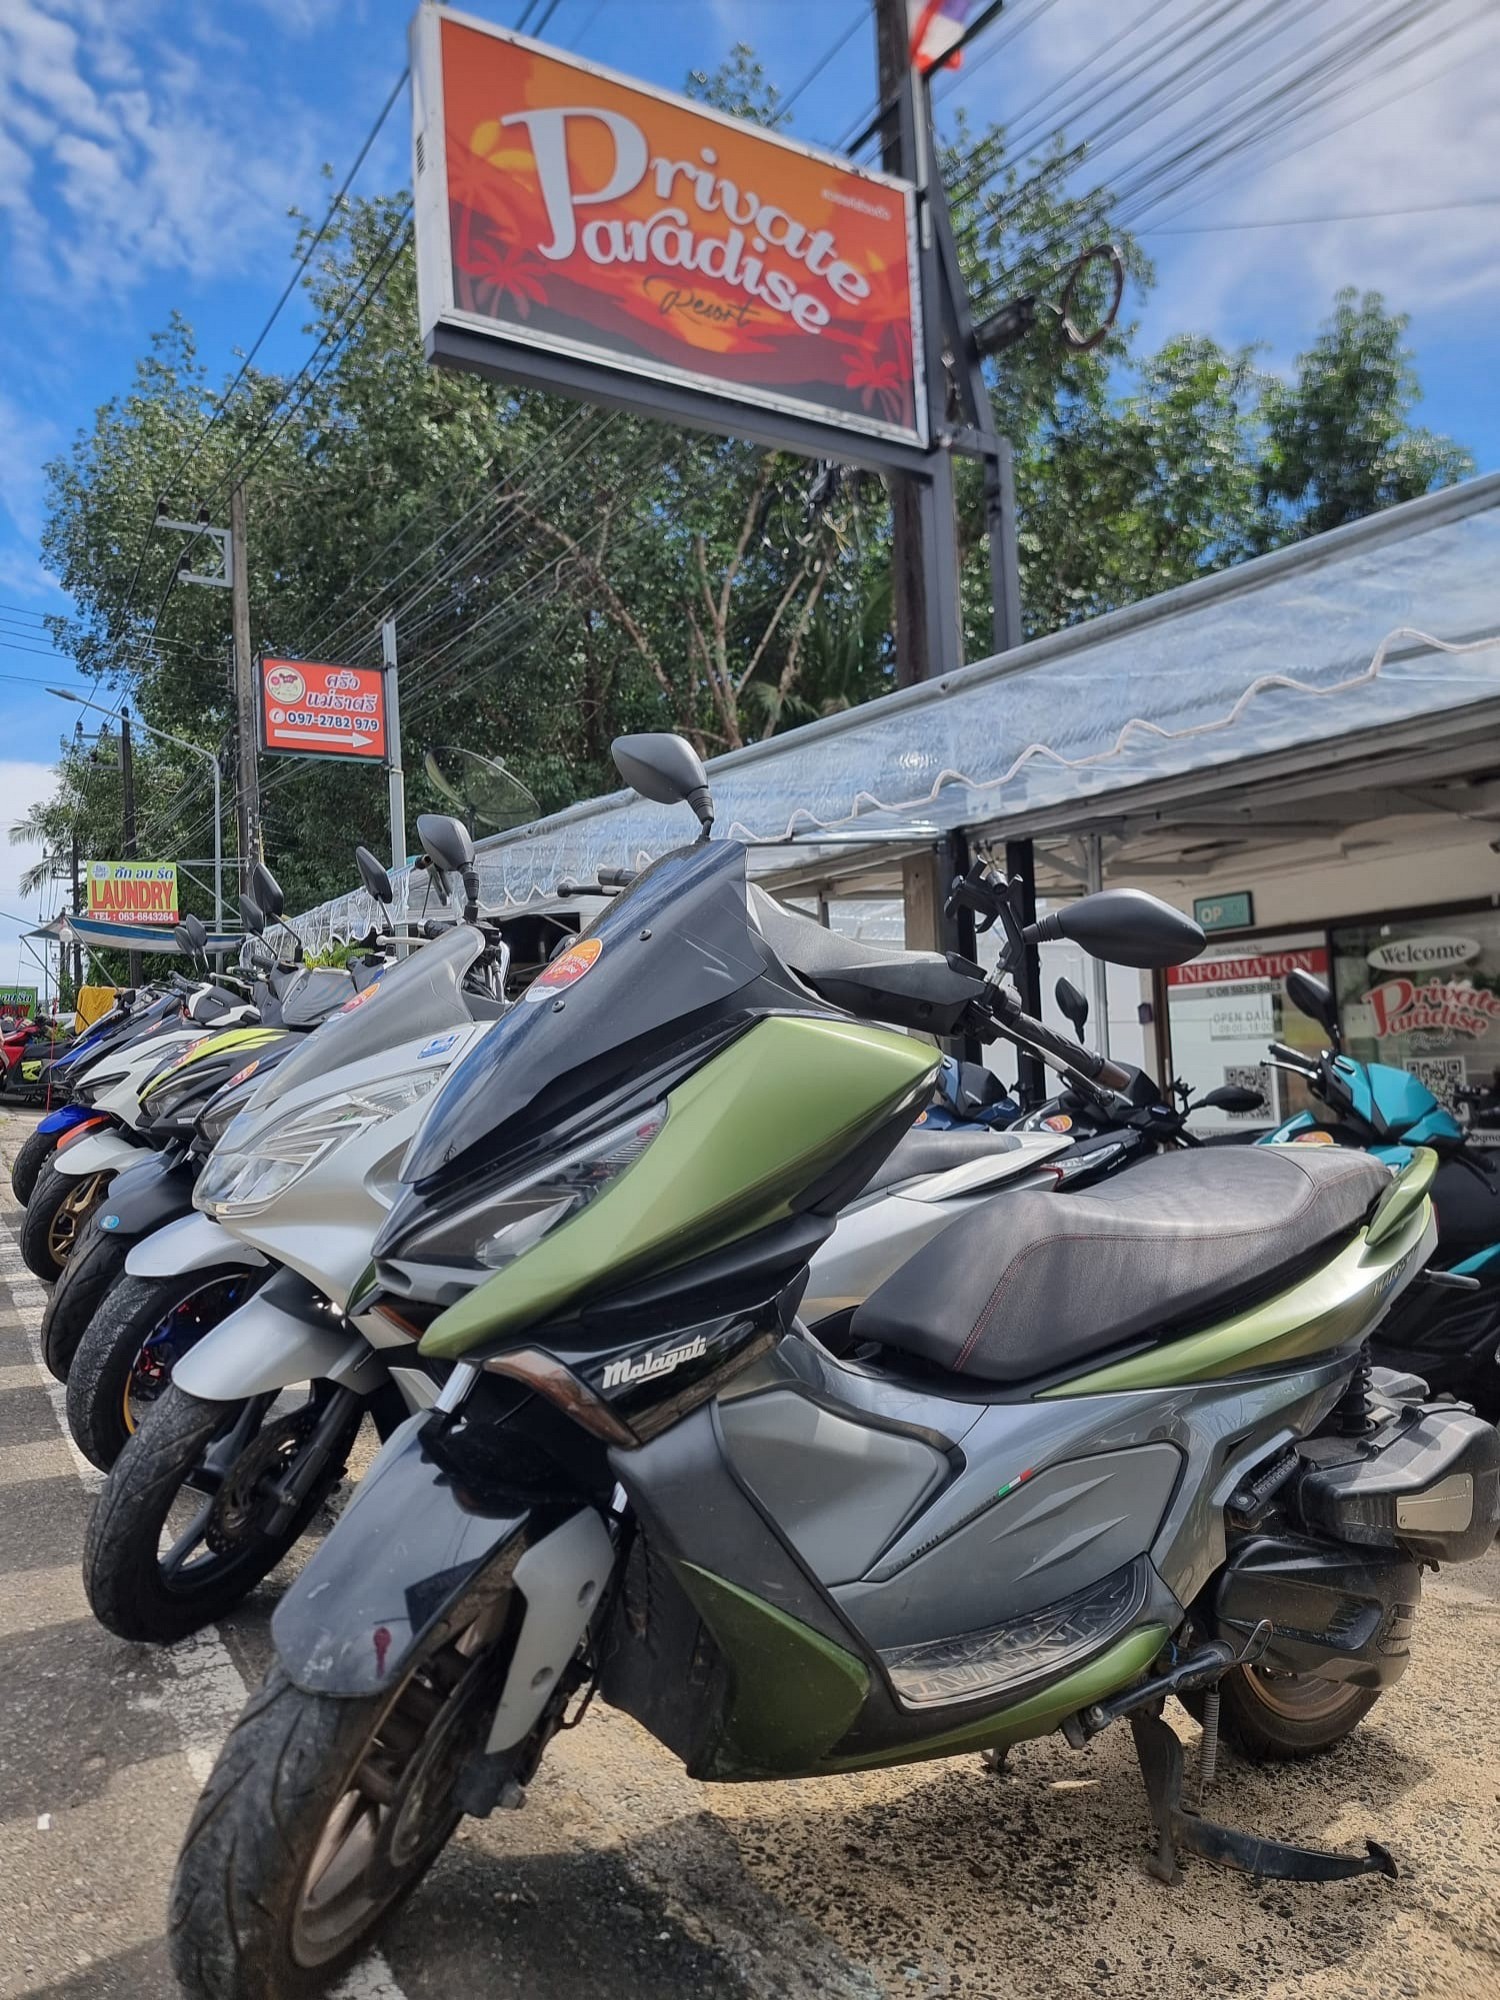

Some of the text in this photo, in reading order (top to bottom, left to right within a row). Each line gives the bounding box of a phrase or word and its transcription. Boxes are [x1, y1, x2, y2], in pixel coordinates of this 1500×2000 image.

[501, 106, 872, 306] Private
[643, 275, 761, 328] Resort
[287, 711, 379, 731] 097-2782 979
[91, 880, 174, 909] LAUNDRY
[93, 911, 111, 921] TEL
[1177, 952, 1312, 983] INFORMATION
[1380, 943, 1467, 964] Welcome
[602, 1335, 707, 1389] Malaguti
